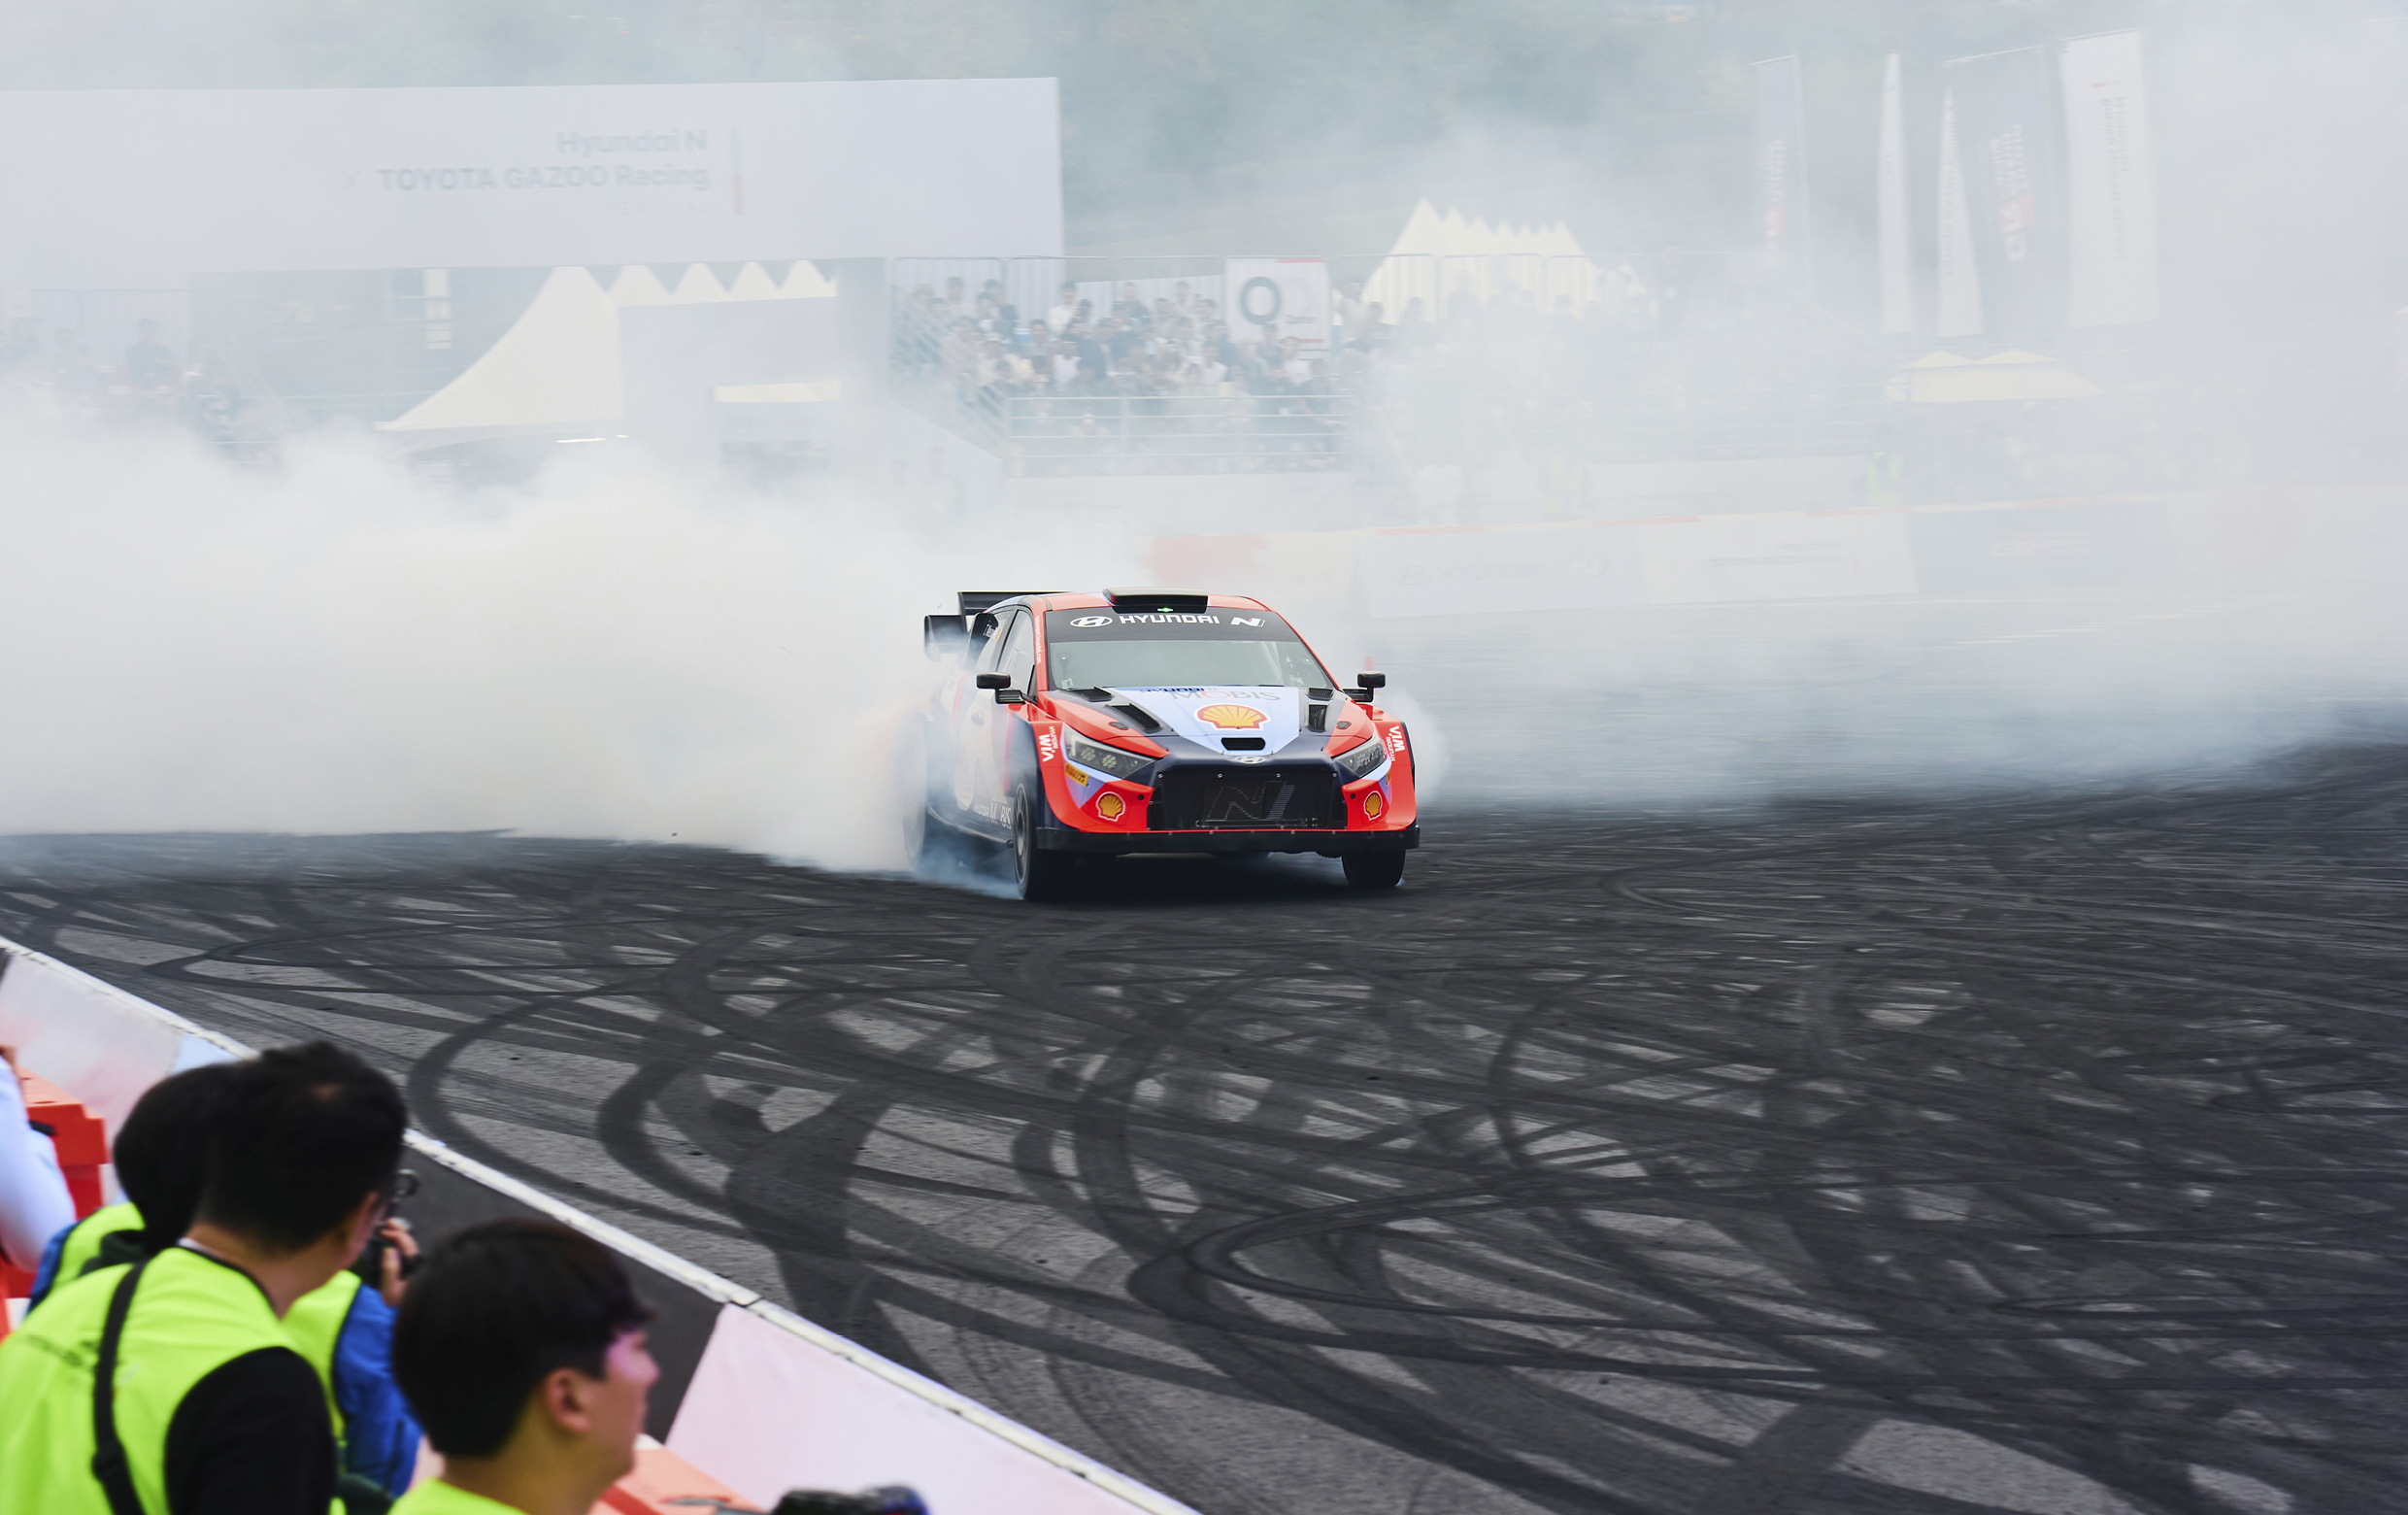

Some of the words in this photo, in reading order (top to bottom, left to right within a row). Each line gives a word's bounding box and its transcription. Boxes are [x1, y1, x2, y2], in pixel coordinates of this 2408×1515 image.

[556, 128, 679, 158] Hyundai
[684, 129, 708, 152] N
[376, 168, 498, 191] TOYOTA
[503, 165, 609, 189] GAZOO
[615, 163, 710, 191] Racing
[1120, 615, 1220, 624] HYUNDAI
[1170, 690, 1281, 701] MOBIS
[1386, 736, 1395, 761] HYUNDAI
